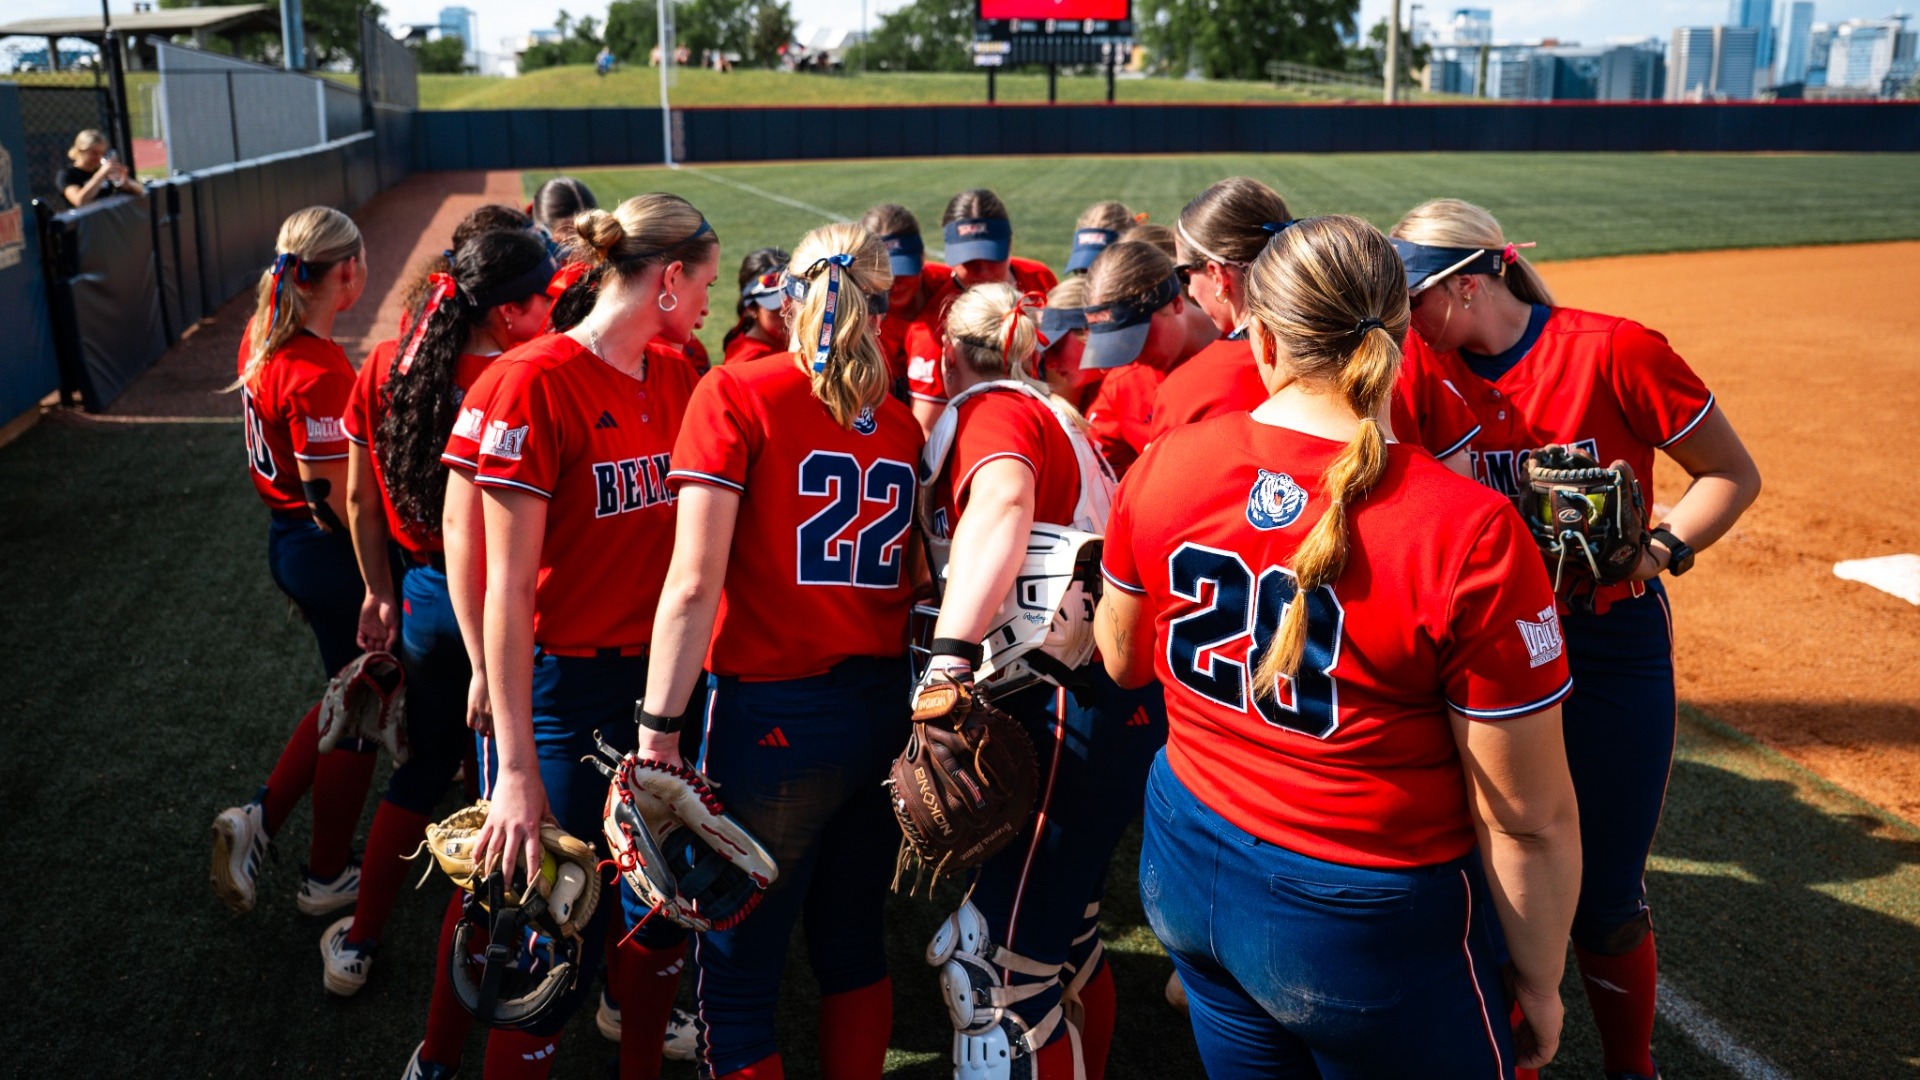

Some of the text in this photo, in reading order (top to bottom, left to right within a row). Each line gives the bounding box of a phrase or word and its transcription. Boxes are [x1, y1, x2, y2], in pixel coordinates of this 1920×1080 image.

[797, 449, 916, 589] 22
[1166, 541, 1345, 741] 28
[914, 766, 953, 837] NOKONA
